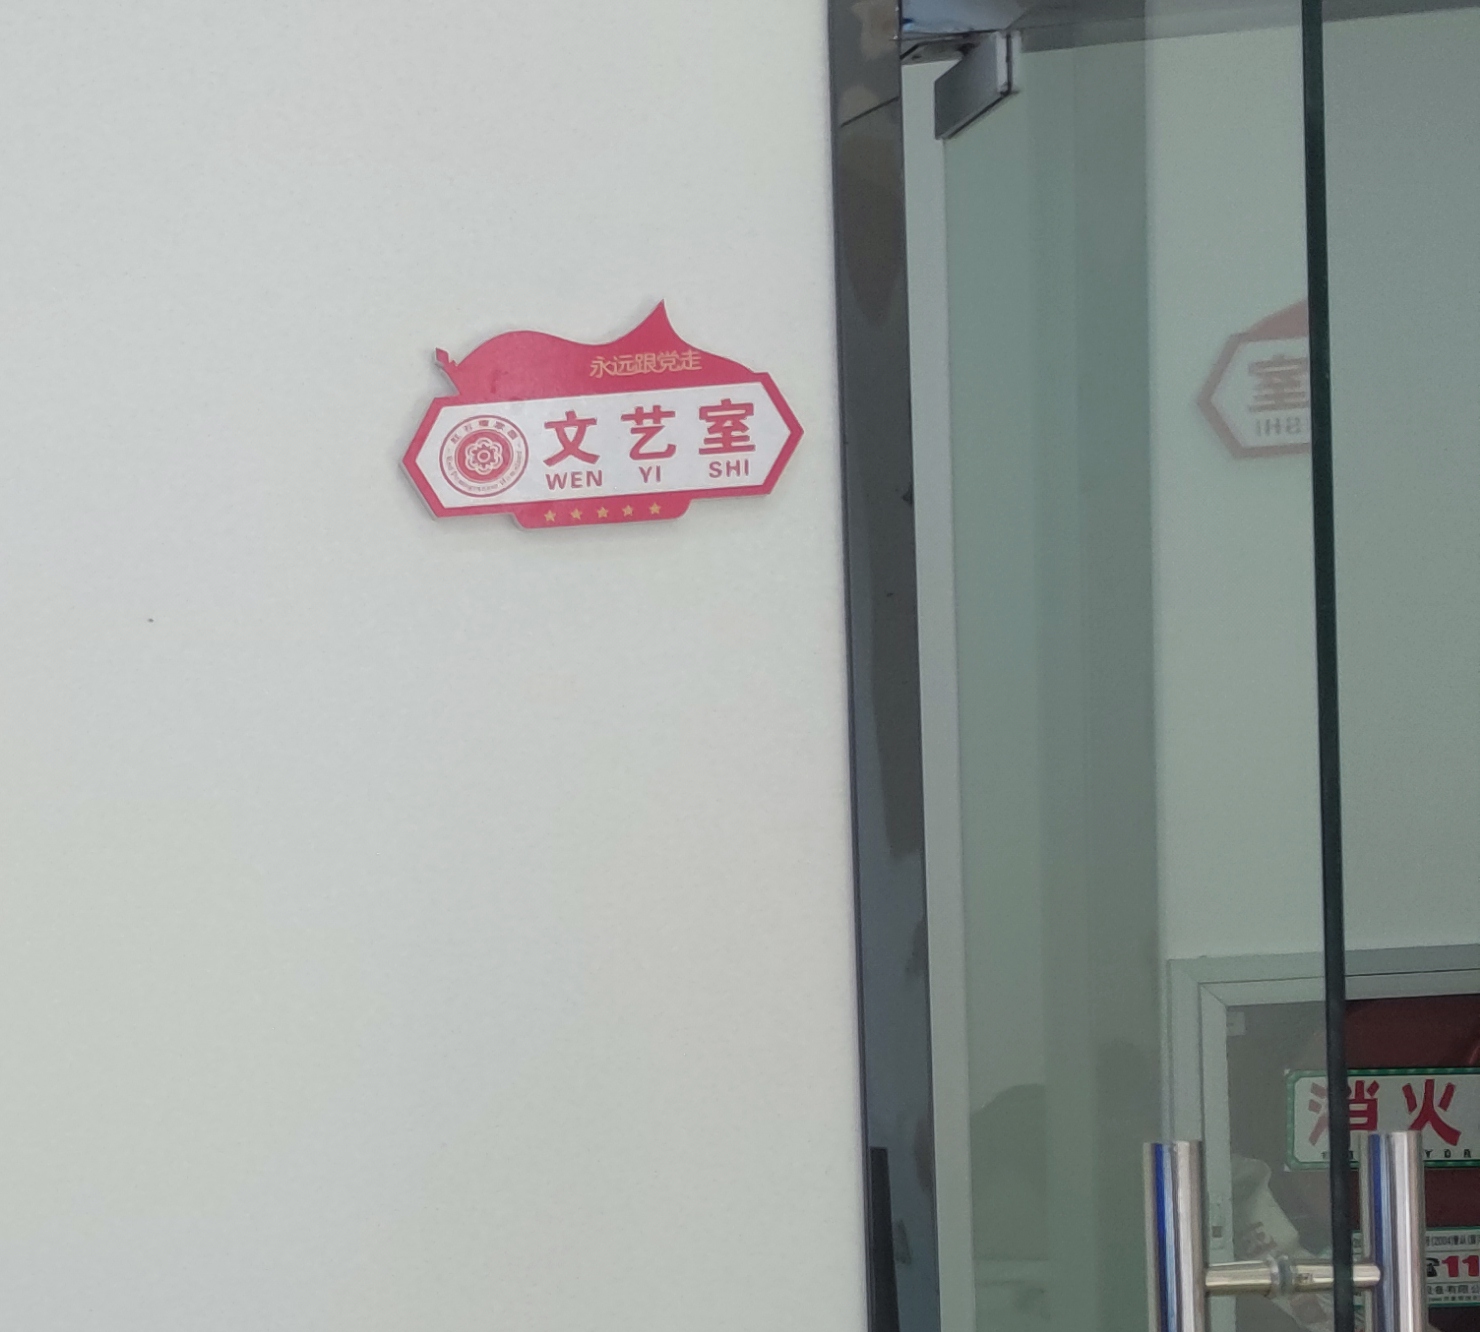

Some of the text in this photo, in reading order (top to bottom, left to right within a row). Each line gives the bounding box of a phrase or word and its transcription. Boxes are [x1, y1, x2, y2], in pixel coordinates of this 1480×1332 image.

[589, 350, 702, 379] 永远跟党走
[543, 399, 756, 467] 文艺室
[546, 469, 603, 490] WEN
[639, 466, 661, 483] YI
[709, 459, 750, 478] SHI
